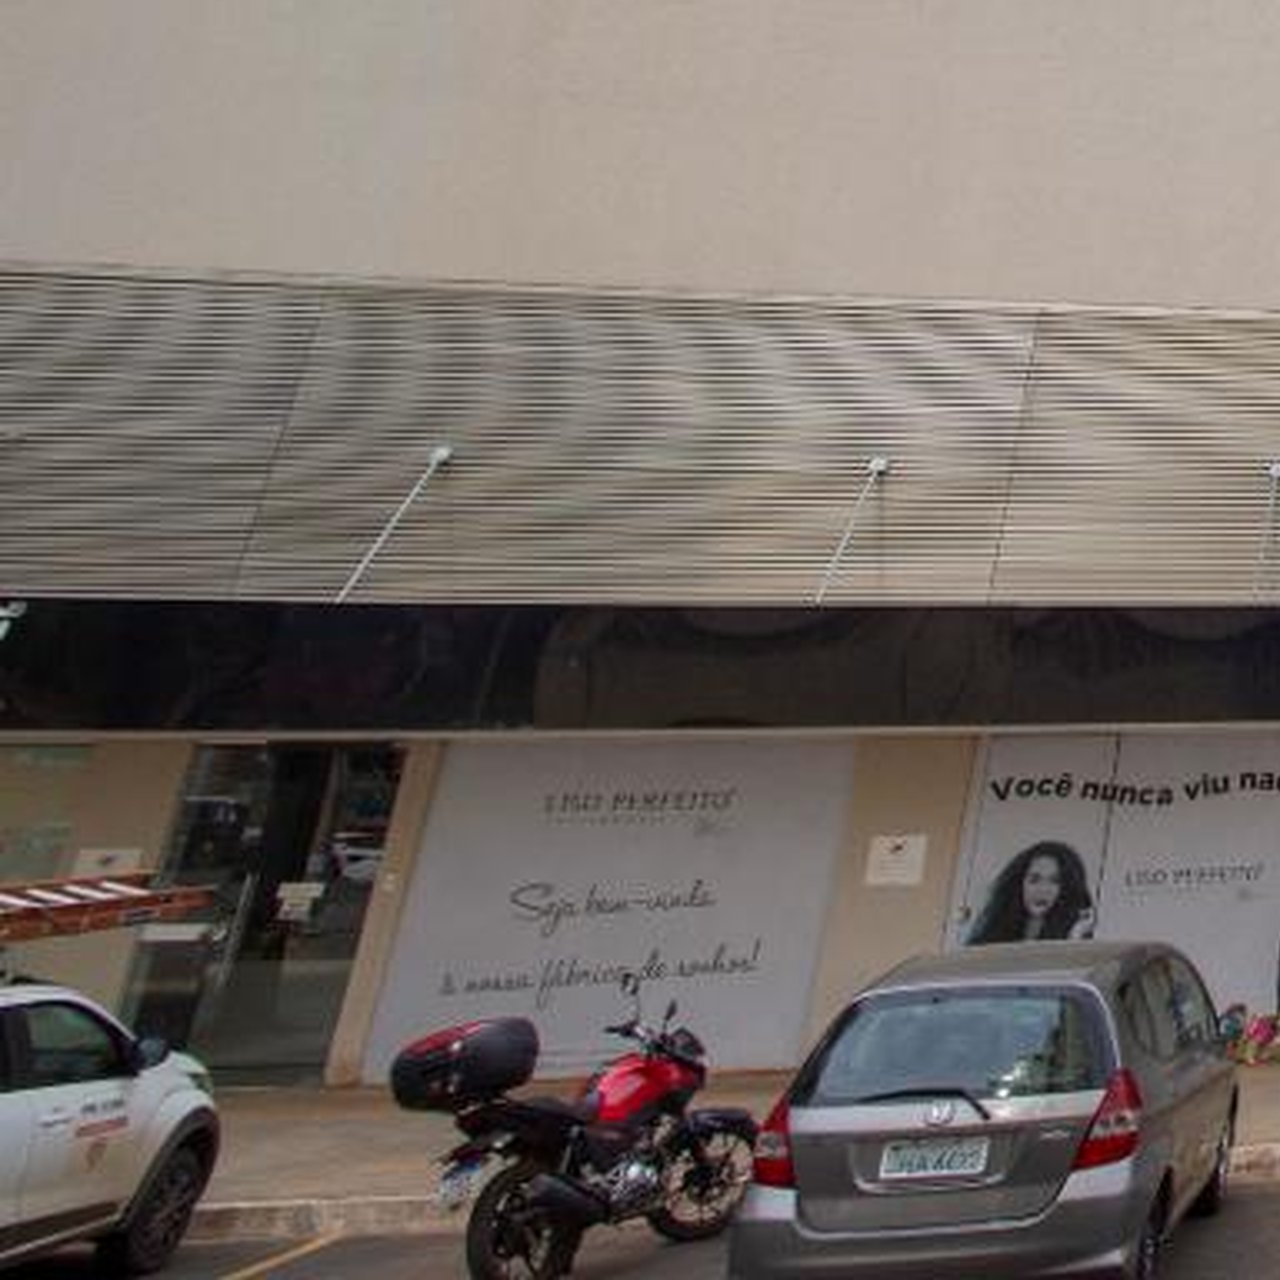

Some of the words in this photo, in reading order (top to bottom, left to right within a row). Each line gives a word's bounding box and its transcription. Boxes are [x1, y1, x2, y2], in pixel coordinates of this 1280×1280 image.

[990, 773, 1074, 802] Você
[1080, 779, 1175, 806] nunca
[1184, 773, 1231, 801] viu
